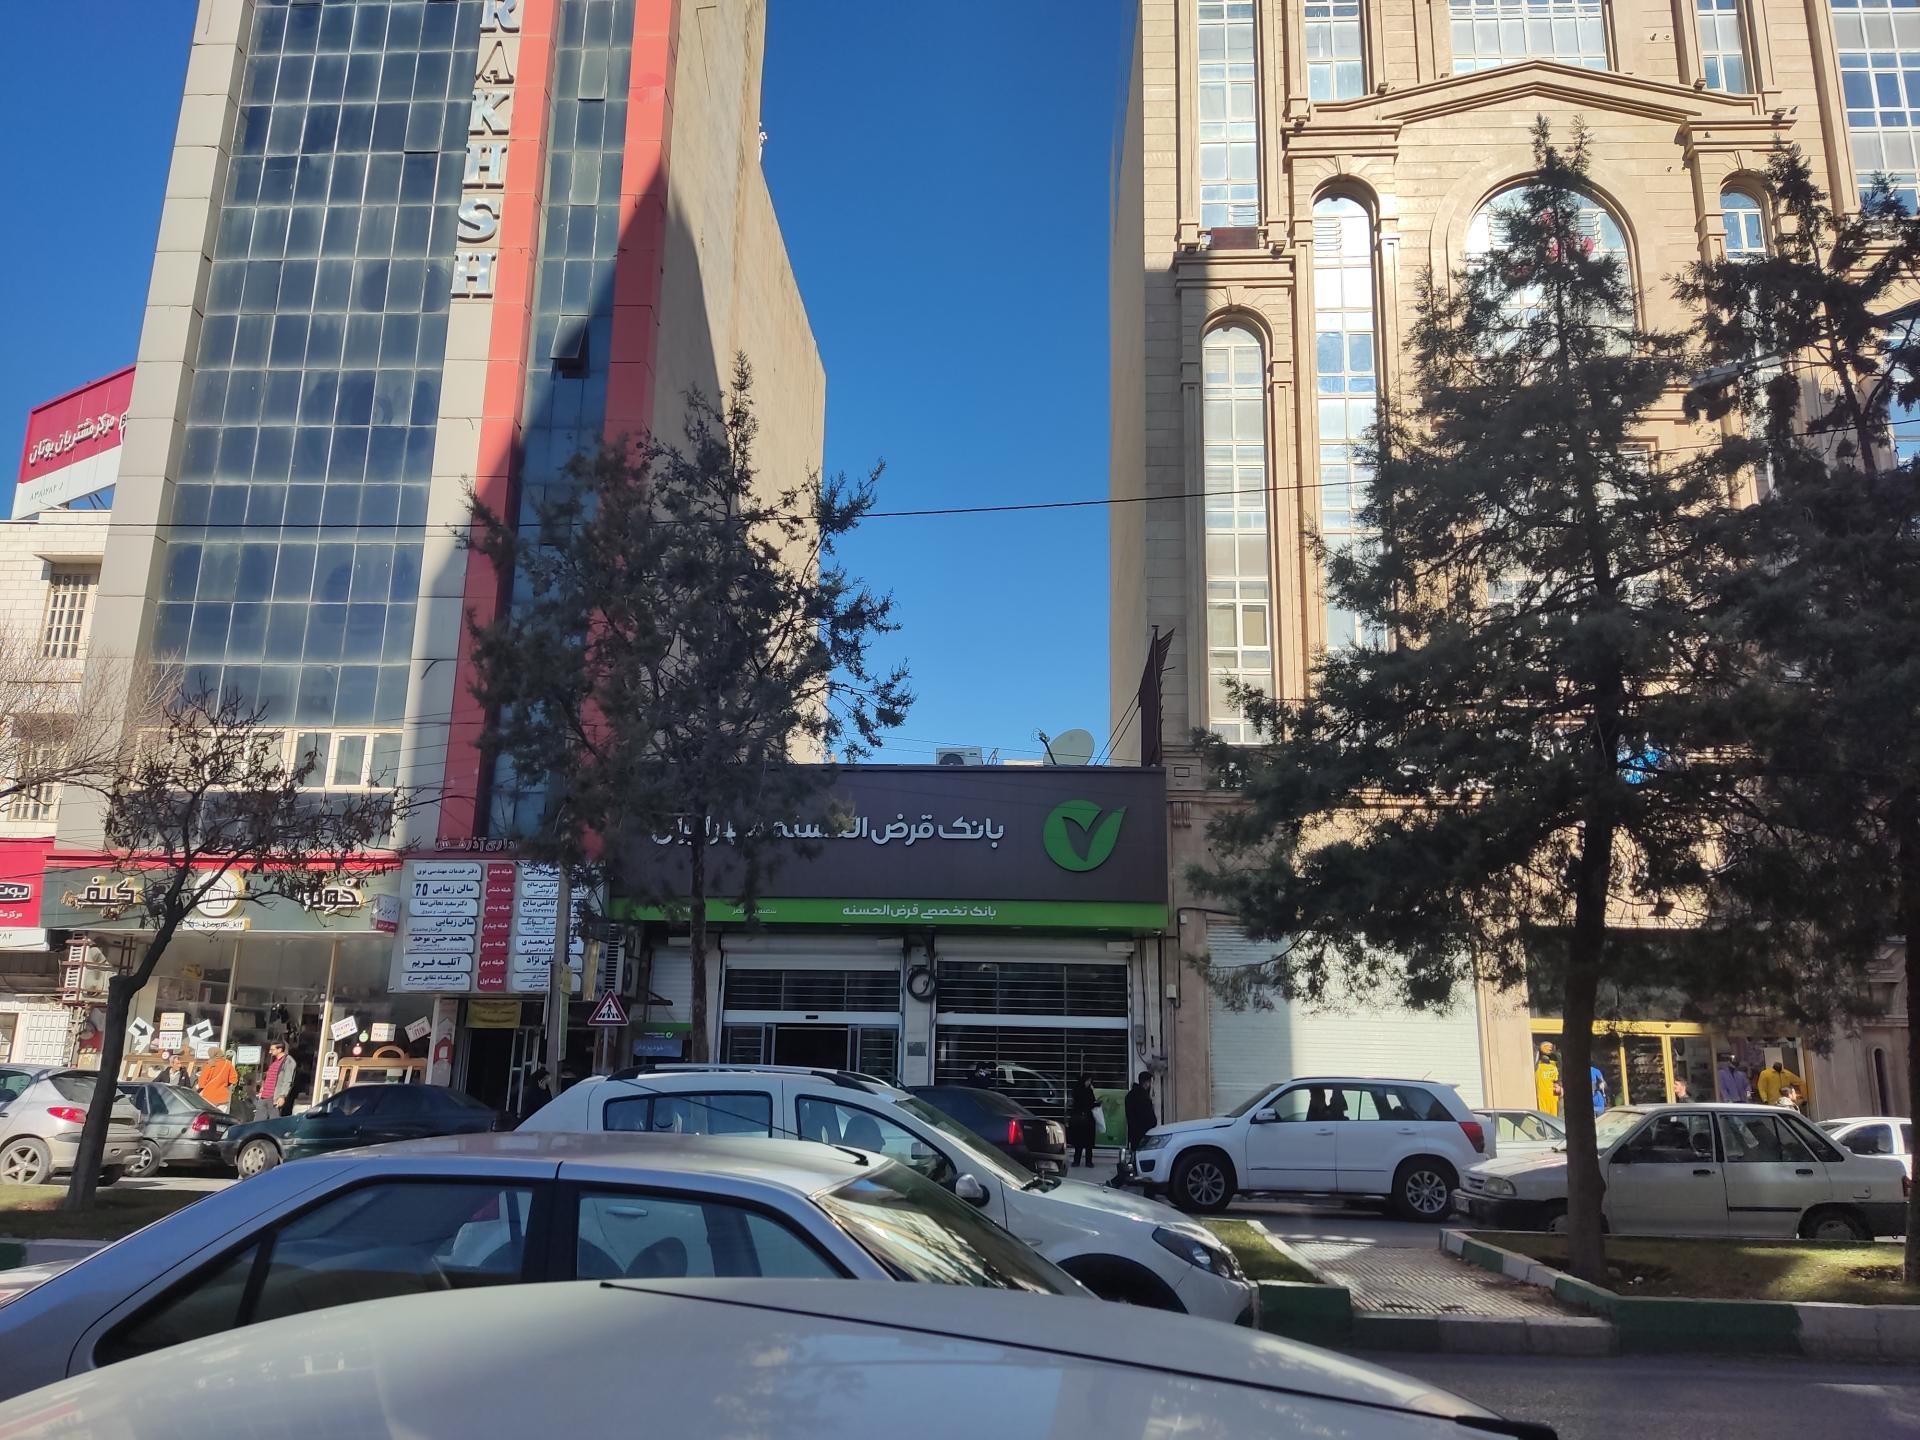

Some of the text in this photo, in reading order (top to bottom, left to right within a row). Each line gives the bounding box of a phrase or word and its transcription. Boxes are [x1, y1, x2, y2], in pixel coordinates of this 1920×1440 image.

[450, 0, 520, 299] RAKHSH
[55, 417, 94, 453] مشتریان
[93, 413, 115, 438] مرکز
[773, 814, 868, 839] السنه
[871, 813, 935, 846] قرض
[938, 816, 1004, 848] بانک
[415, 883, 474, 897] سالن زیبایی 70
[7, 910, 23, 919] مرکز
[435, 917, 475, 928] سالن زیبایی
[842, 903, 997, 920] بانک تخصصی قرض الحسنه
[411, 956, 462, 968] آتلیه فریم
